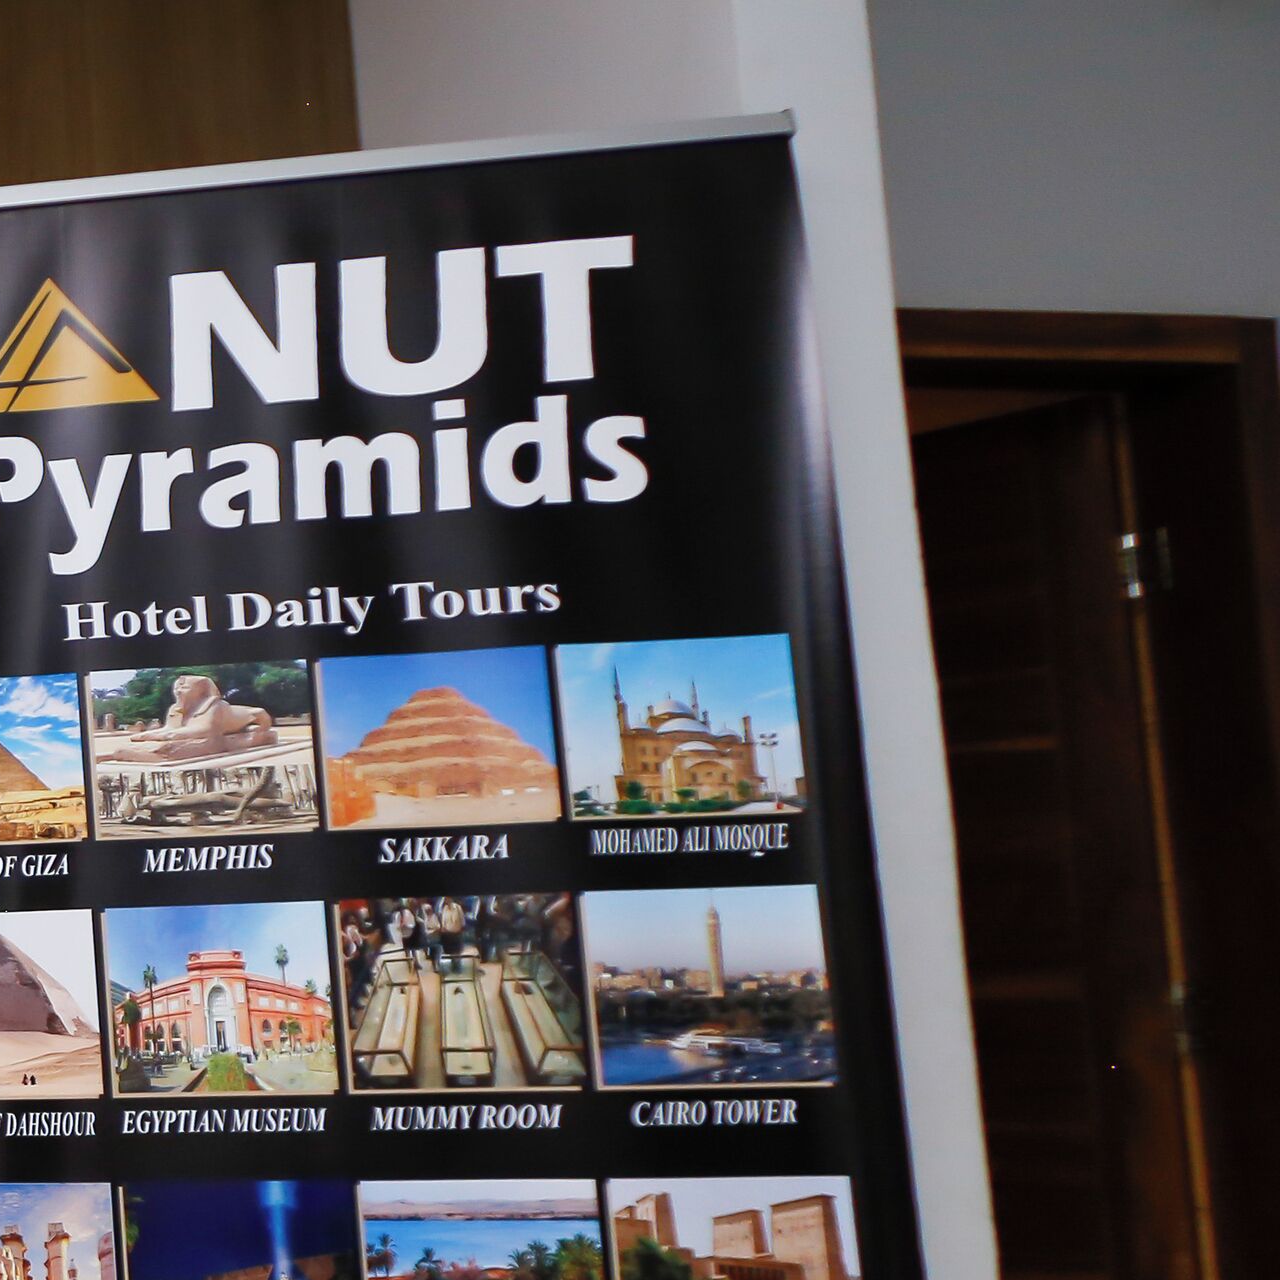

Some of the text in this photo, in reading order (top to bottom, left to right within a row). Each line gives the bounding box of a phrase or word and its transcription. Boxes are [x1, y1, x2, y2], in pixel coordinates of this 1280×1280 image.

[170, 234, 635, 413] NUT
[63, 579, 562, 642] Hotel Daily Tours
[378, 834, 509, 864] SAKKARA
[591, 823, 789, 857] MOHAMED ALI MOSQUE
[22, 853, 69, 877] GIZA
[143, 844, 274, 873] MEMPHIS
[6, 1111, 96, 1138] DAHSHOUR
[122, 1107, 327, 1134] EGYPTIAN MUSEUM
[370, 1104, 563, 1131] MUMMY ROOM
[630, 1100, 797, 1127] CAIRO TOWER
